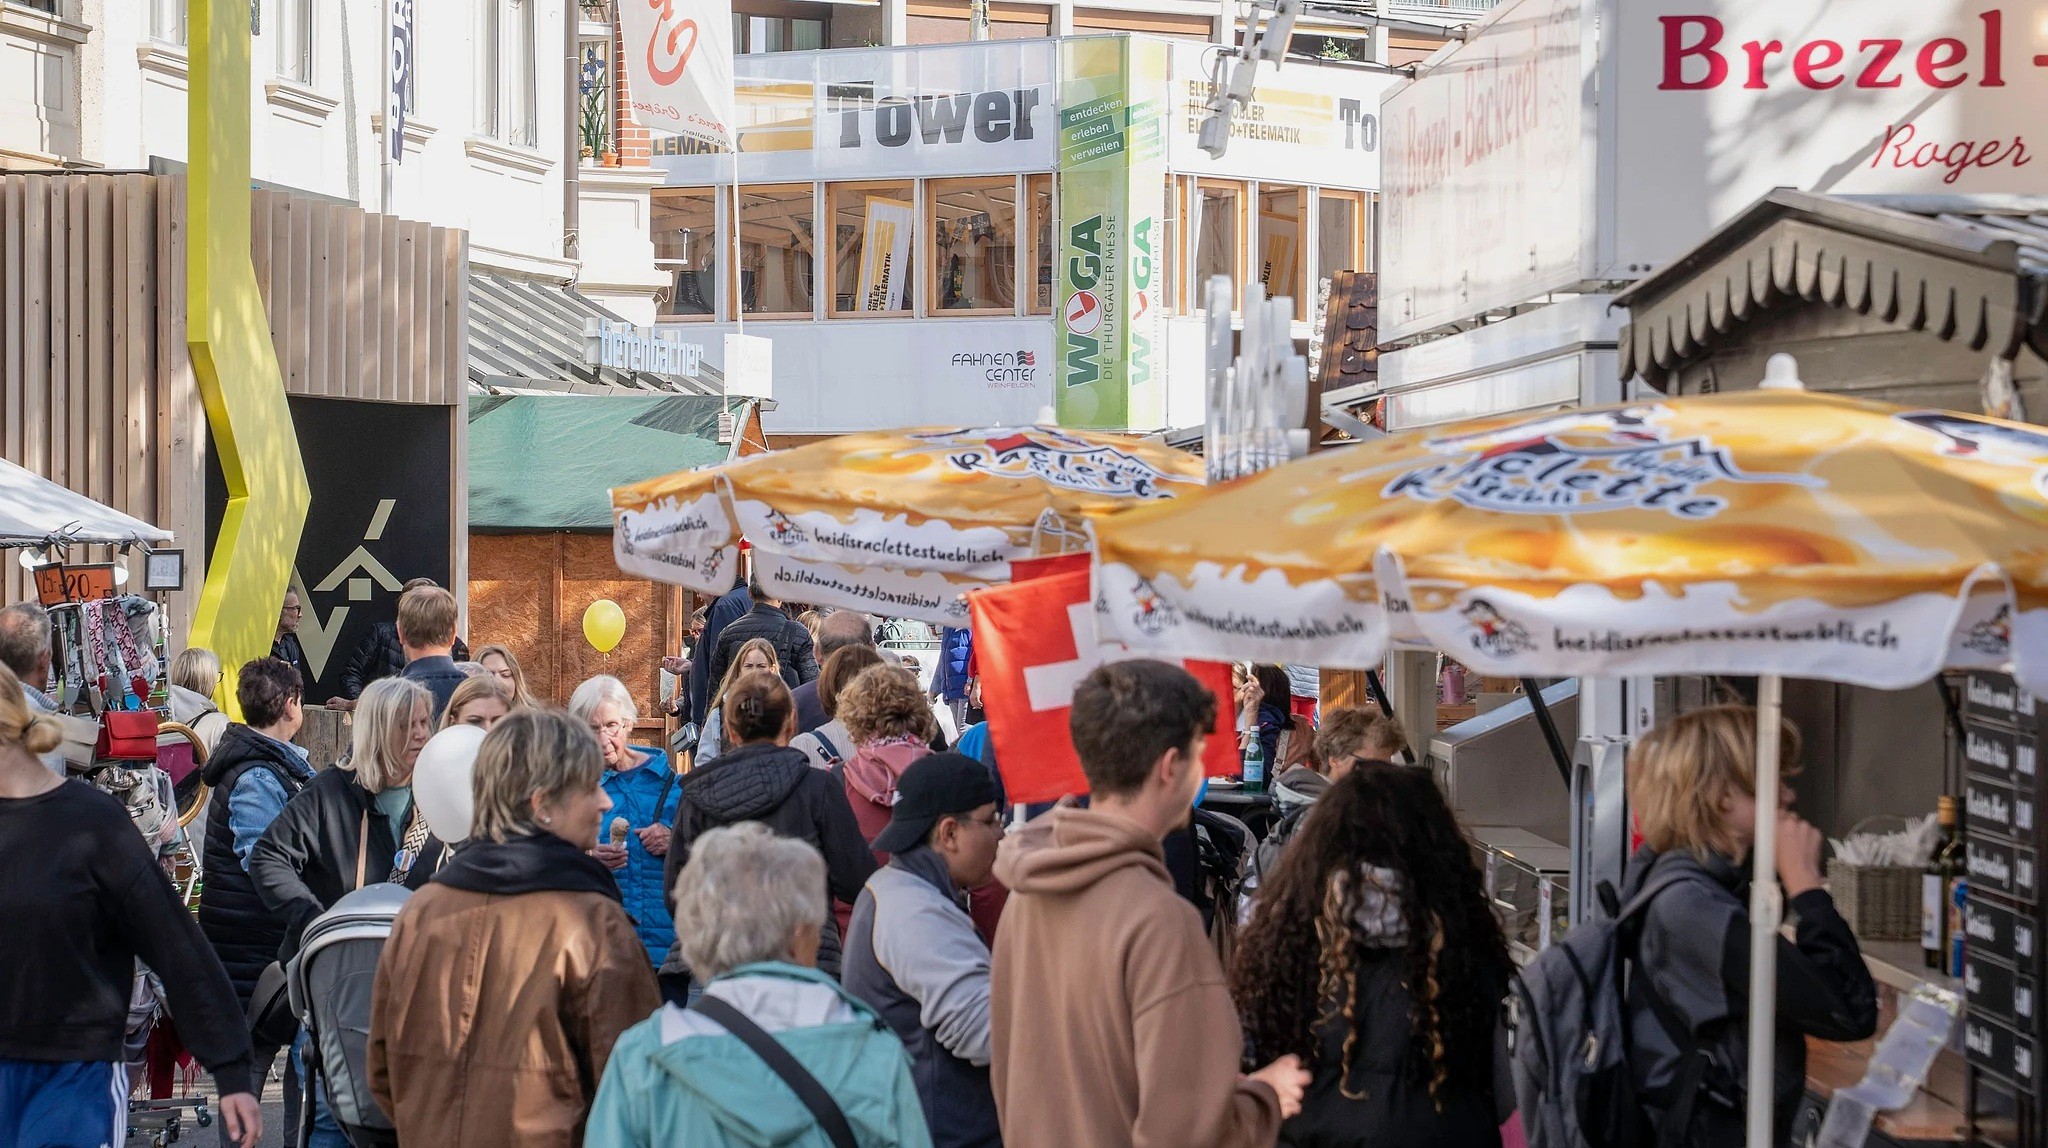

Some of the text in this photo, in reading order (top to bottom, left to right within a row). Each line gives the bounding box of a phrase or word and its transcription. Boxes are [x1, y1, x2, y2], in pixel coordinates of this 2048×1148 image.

[827, 80, 1039, 149] Tower
[1069, 97, 1123, 122] entdecken
[1070, 120, 1110, 142] erleben
[1187, 117, 1301, 144] ELO+TELEMATIK
[1339, 97, 1377, 153] To
[1069, 138, 1121, 163] verweilen
[1870, 123, 2033, 185] Roger
[1103, 214, 1117, 380] DIE THURGAUER MESSE
[951, 352, 1014, 367] FAHNEN
[985, 368, 1036, 382] CENTER
[814, 528, 1004, 564] heidisraclettestuebli.ch
